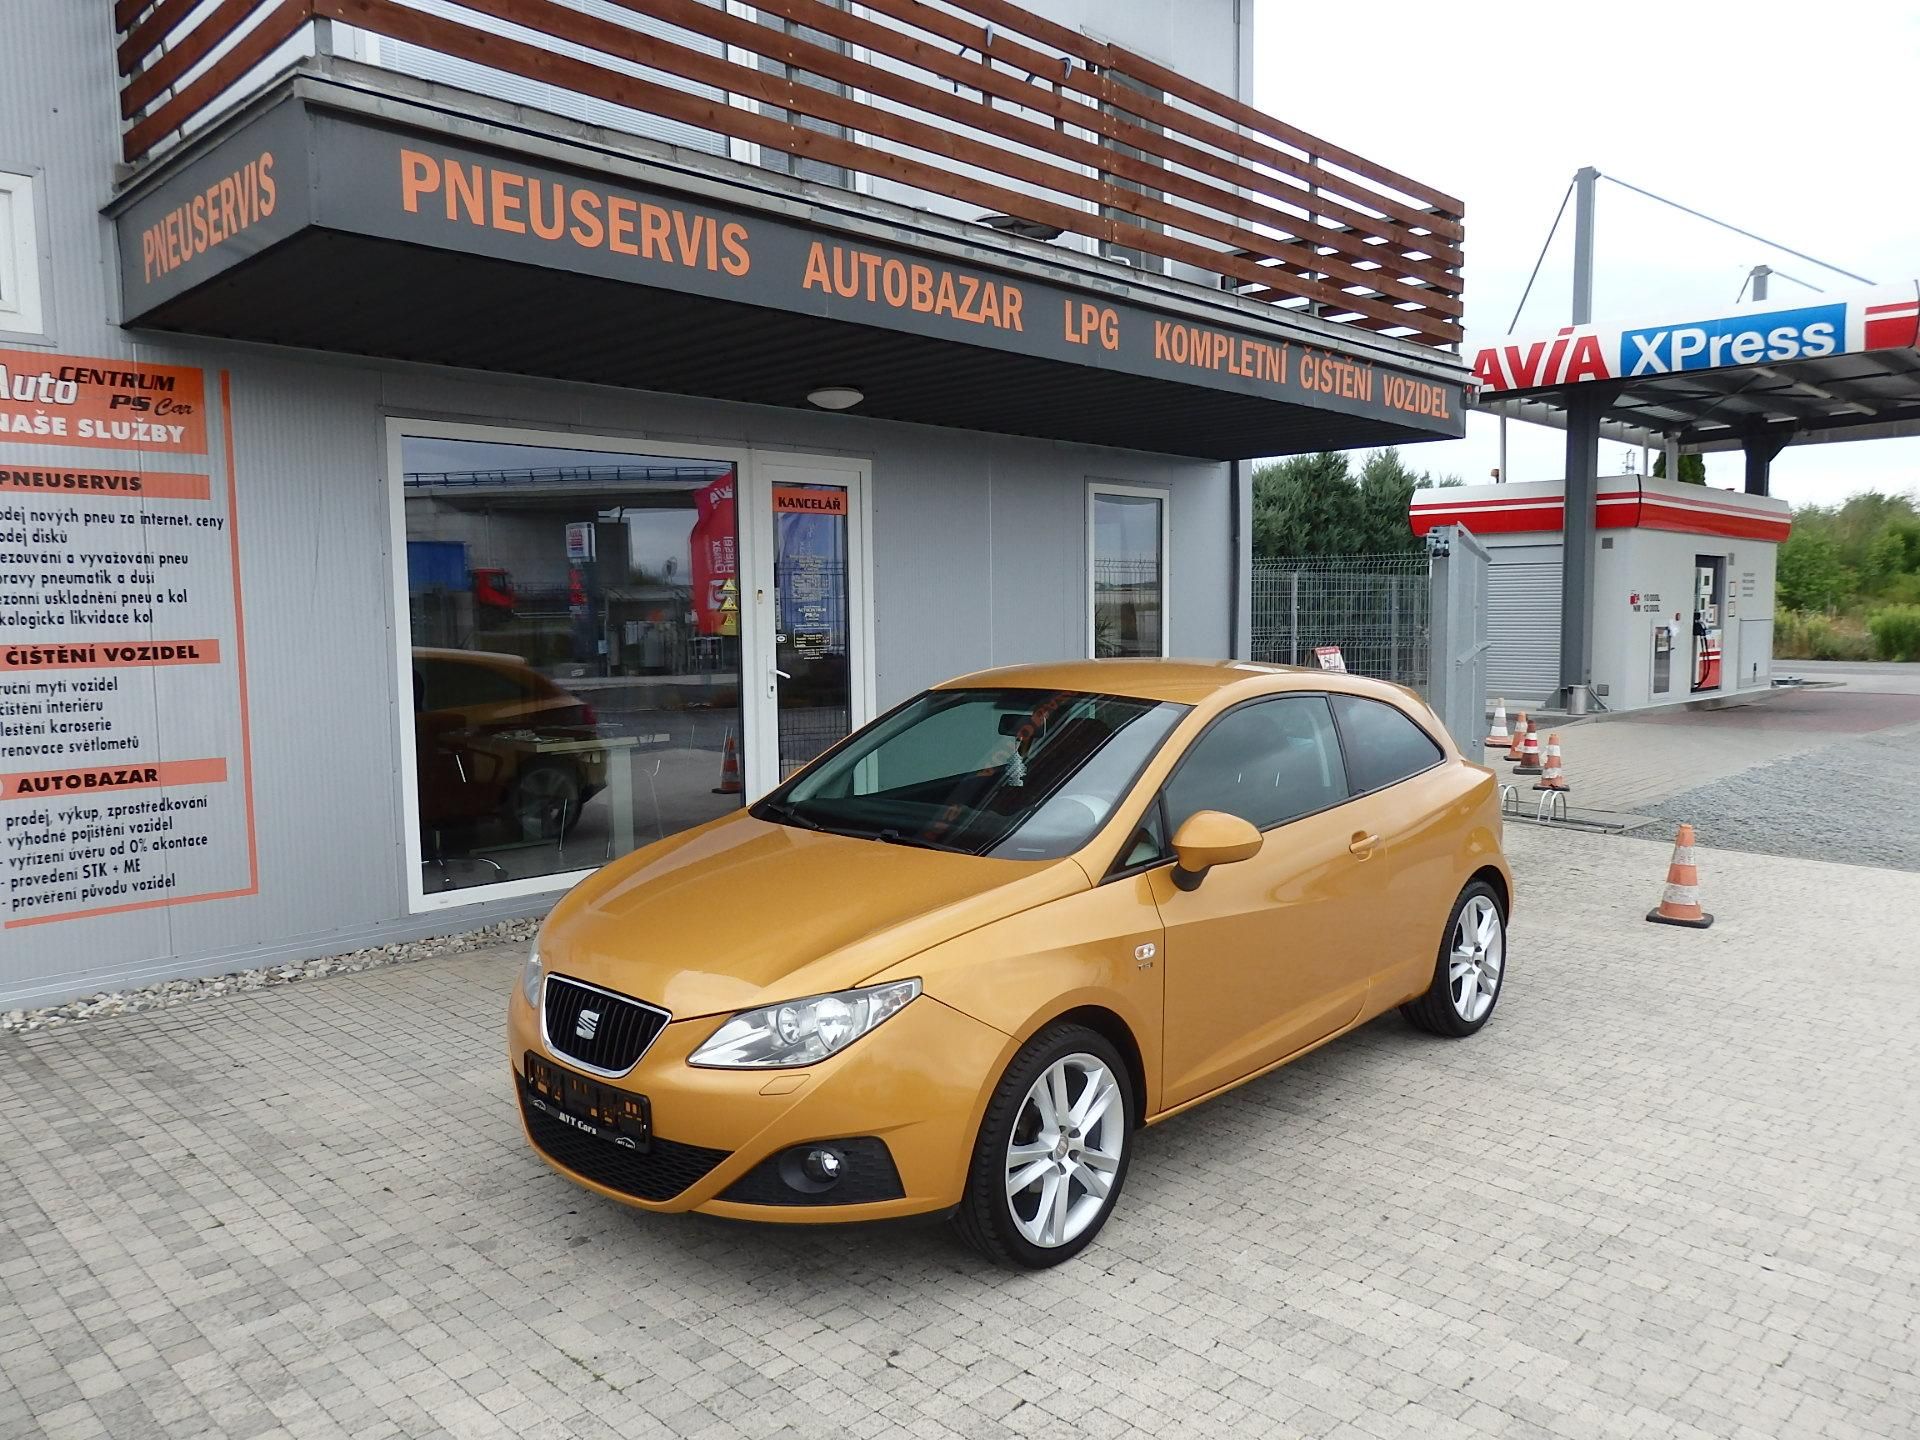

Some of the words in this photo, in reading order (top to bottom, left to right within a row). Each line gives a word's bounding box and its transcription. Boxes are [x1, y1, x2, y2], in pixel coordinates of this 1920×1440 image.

[142, 151, 276, 284] PNEUSERVIS
[400, 148, 751, 277] PNEUSERVIS
[803, 241, 1023, 331] AUTOBAZAR
[1064, 299, 1120, 351] LPG
[1154, 320, 1290, 384] KOMPLETNÍ
[1299, 345, 1374, 402] ČIŠTĚNÍ
[1382, 374, 1450, 419] VOZIDEL
[1630, 322, 1836, 376] XPress
[58, 366, 175, 391] CENTRUM
[109, 394, 152, 411] PS
[154, 397, 194, 416] Car
[78, 417, 185, 443] SLUŽBY
[778, 496, 841, 511] KANCELÁŘ
[30, 508, 79, 526] nových
[84, 513, 115, 526] pneu
[120, 515, 135, 524] za
[196, 517, 224, 530] ceny
[32, 528, 68, 543] disků
[67, 554, 74, 564] a
[81, 551, 154, 567] vyvažování
[159, 553, 189, 567] pneu
[41, 569, 112, 588] pneumatik
[118, 575, 125, 584] a
[130, 569, 155, 584] duší
[45, 590, 117, 605] uskladnění
[122, 594, 152, 607] pneu
[157, 594, 164, 603] a
[168, 589, 188, 603] kol
[70, 609, 129, 624] likvidace
[134, 609, 153, 624] kol
[6, 644, 96, 665] ČIŠTĚNÍ
[103, 645, 199, 662] VOZIDEL
[72, 676, 118, 692] vozidel
[47, 698, 103, 714] interiéru
[0, 720, 46, 736] leštění
[50, 717, 112, 734] karoserie
[1, 743, 64, 757] renovace
[69, 735, 139, 753] světlometů
[17, 768, 158, 793] AUTOBAZAR
[107, 795, 208, 819] zprostředkování
[8, 829, 66, 850] výhodné
[72, 823, 124, 844] pojištění
[129, 816, 173, 834] vozidel
[9, 849, 64, 870] vyřízení
[69, 846, 105, 861] úvěru
[110, 841, 125, 856] od
[129, 838, 147, 854] 0%
[152, 835, 208, 851] akontace
[11, 868, 78, 891] provedení
[83, 862, 107, 879] STK
[124, 858, 141, 874] ME
[12, 886, 77, 912] prověření
[82, 880, 127, 901] původu
[132, 873, 176, 892] vozidel
